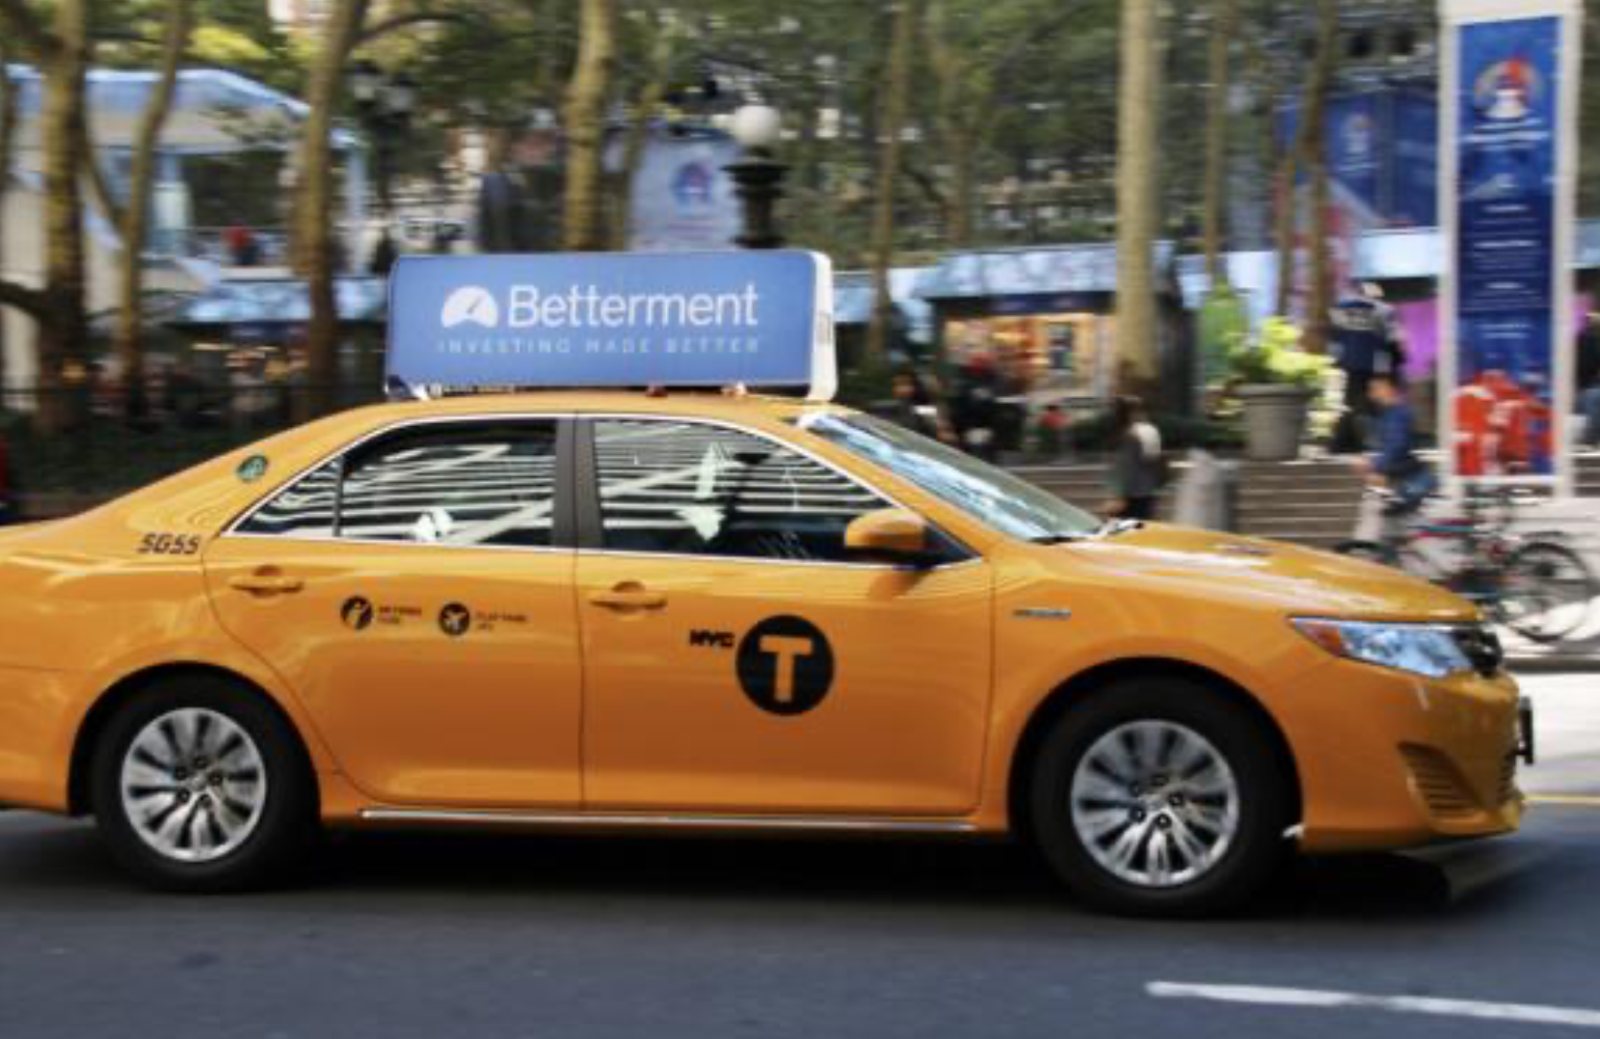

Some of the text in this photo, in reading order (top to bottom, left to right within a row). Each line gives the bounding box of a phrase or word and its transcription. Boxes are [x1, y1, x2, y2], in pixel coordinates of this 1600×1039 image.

[507, 283, 759, 328] Betterment
[437, 337, 759, 354] INVESTING MADE BETTER
[689, 628, 813, 702] NYC T
